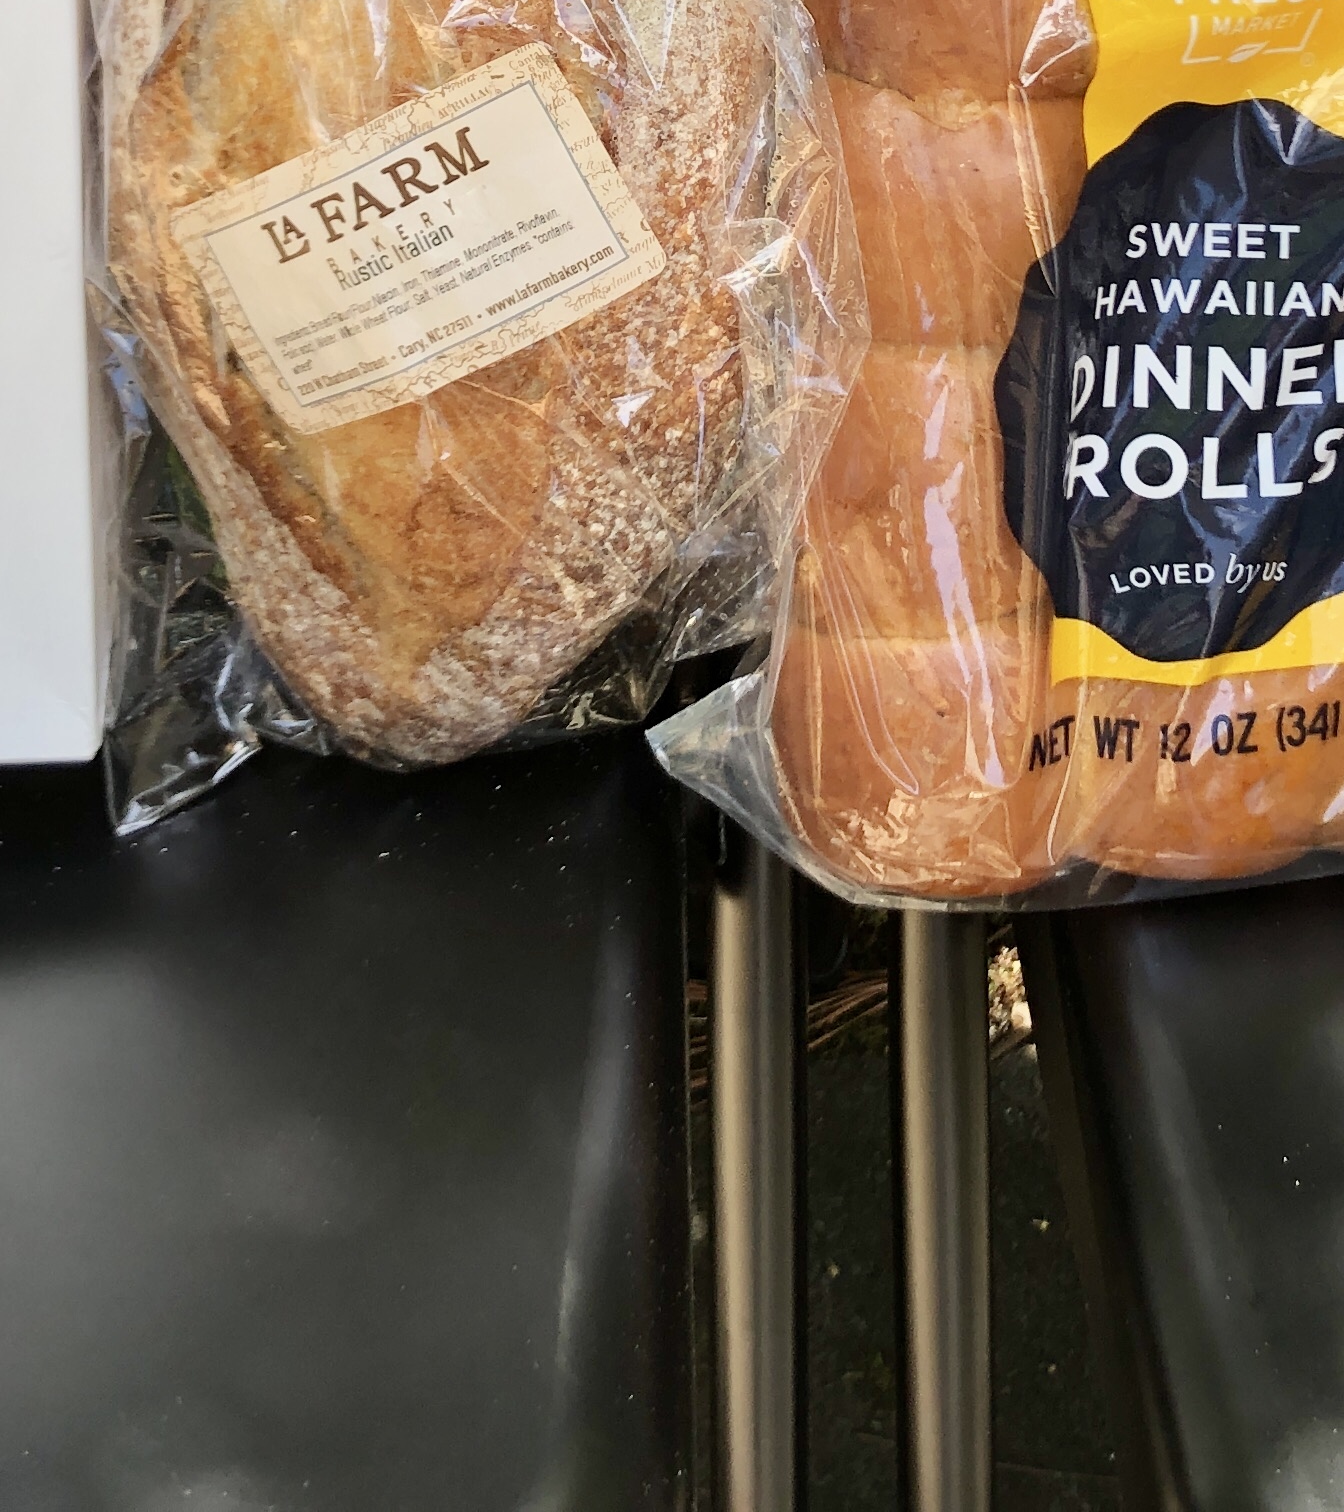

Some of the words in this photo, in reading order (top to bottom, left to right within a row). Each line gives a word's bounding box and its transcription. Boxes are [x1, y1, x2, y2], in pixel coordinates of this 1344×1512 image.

[1212, 12, 1303, 35] MARKET
[261, 211, 312, 264] LA
[310, 126, 490, 242] FARM
[326, 199, 456, 273] BAKERY
[334, 249, 393, 290] Rustic
[391, 220, 453, 263] Italian
[1125, 222, 1300, 259] SWEET
[485, 246, 614, 315] www.lafarmbakery.com
[397, 336, 428, 358] Cary,
[426, 328, 443, 343] NC
[443, 314, 473, 335] 27511
[1110, 563, 1215, 594] LOVED
[1225, 553, 1259, 593] by
[1029, 715, 1075, 772] NET
[1093, 715, 1140, 763] WT
[1159, 723, 1191, 763] 12
[1211, 712, 1258, 756] OZ
[1275, 700, 1341, 753] (341
